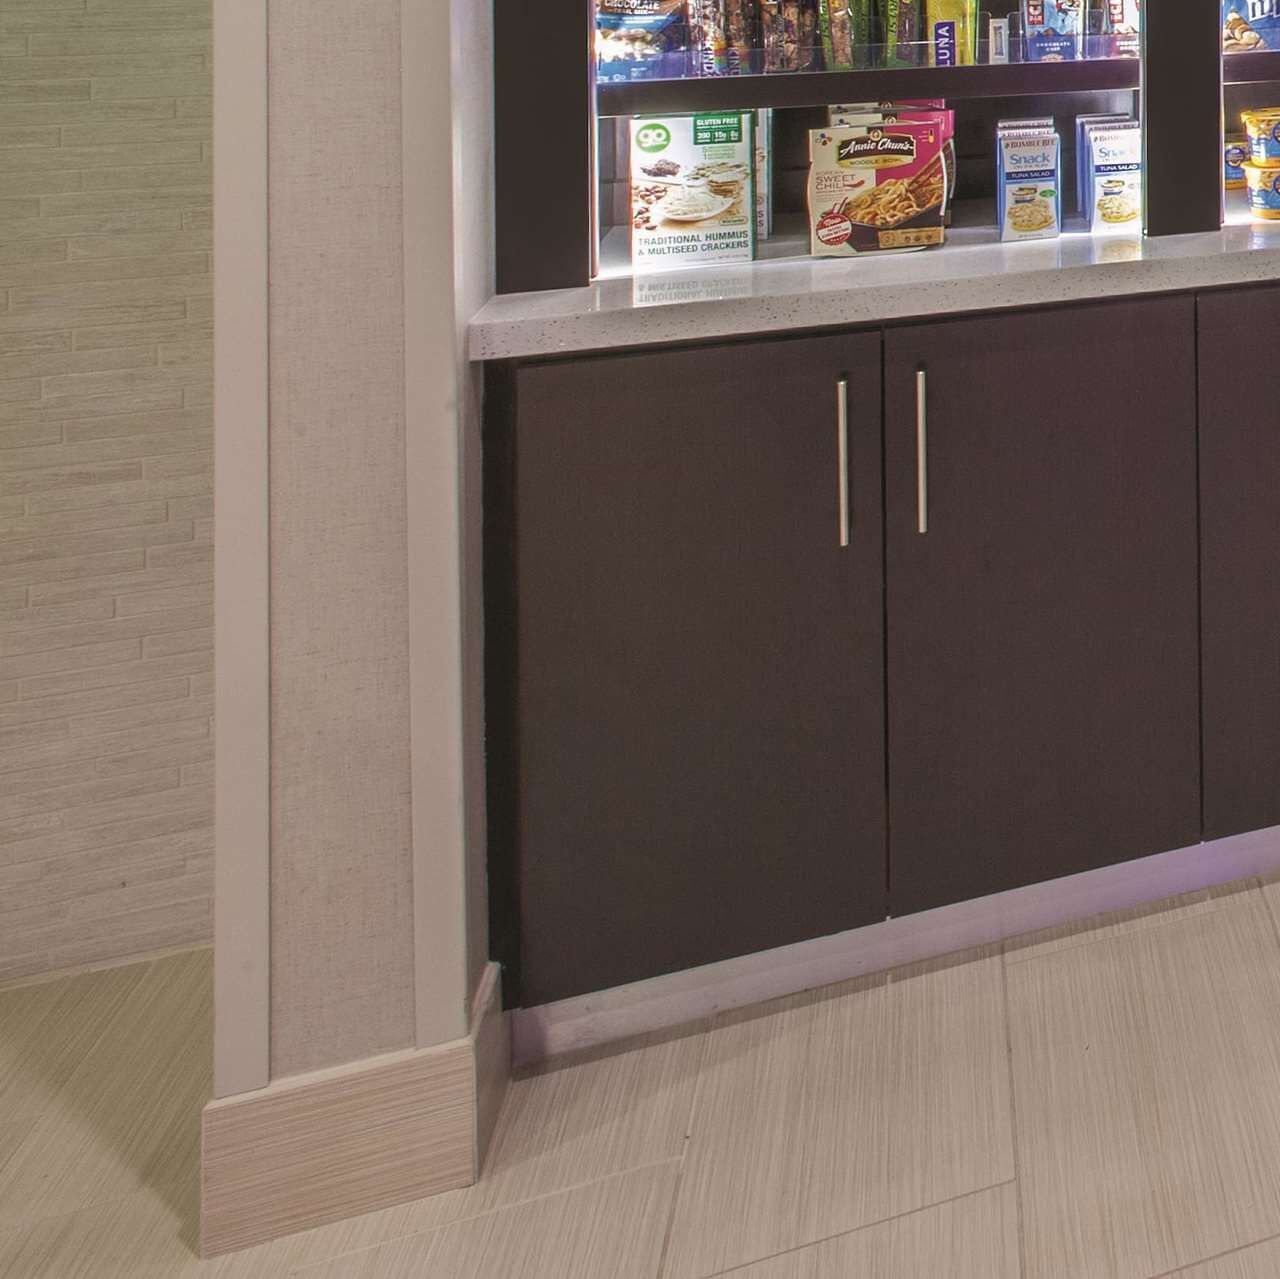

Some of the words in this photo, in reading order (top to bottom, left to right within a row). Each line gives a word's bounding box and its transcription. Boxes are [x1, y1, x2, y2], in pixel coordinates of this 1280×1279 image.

[936, 24, 950, 66] LUNA
[703, 39, 715, 72] KIND
[696, 118, 721, 127] GLUTEN
[722, 117, 738, 125] FREE
[840, 140, 875, 158] Annie
[877, 137, 914, 151] Chun's
[1010, 152, 1050, 166] Snack
[815, 174, 856, 184] SWEET
[1030, 170, 1050, 178] SALAD
[638, 233, 702, 247] TRADITIONAL
[704, 230, 749, 242] HUMMUS
[647, 244, 698, 256] MULTISEED
[700, 239, 749, 253] CRACKERS
